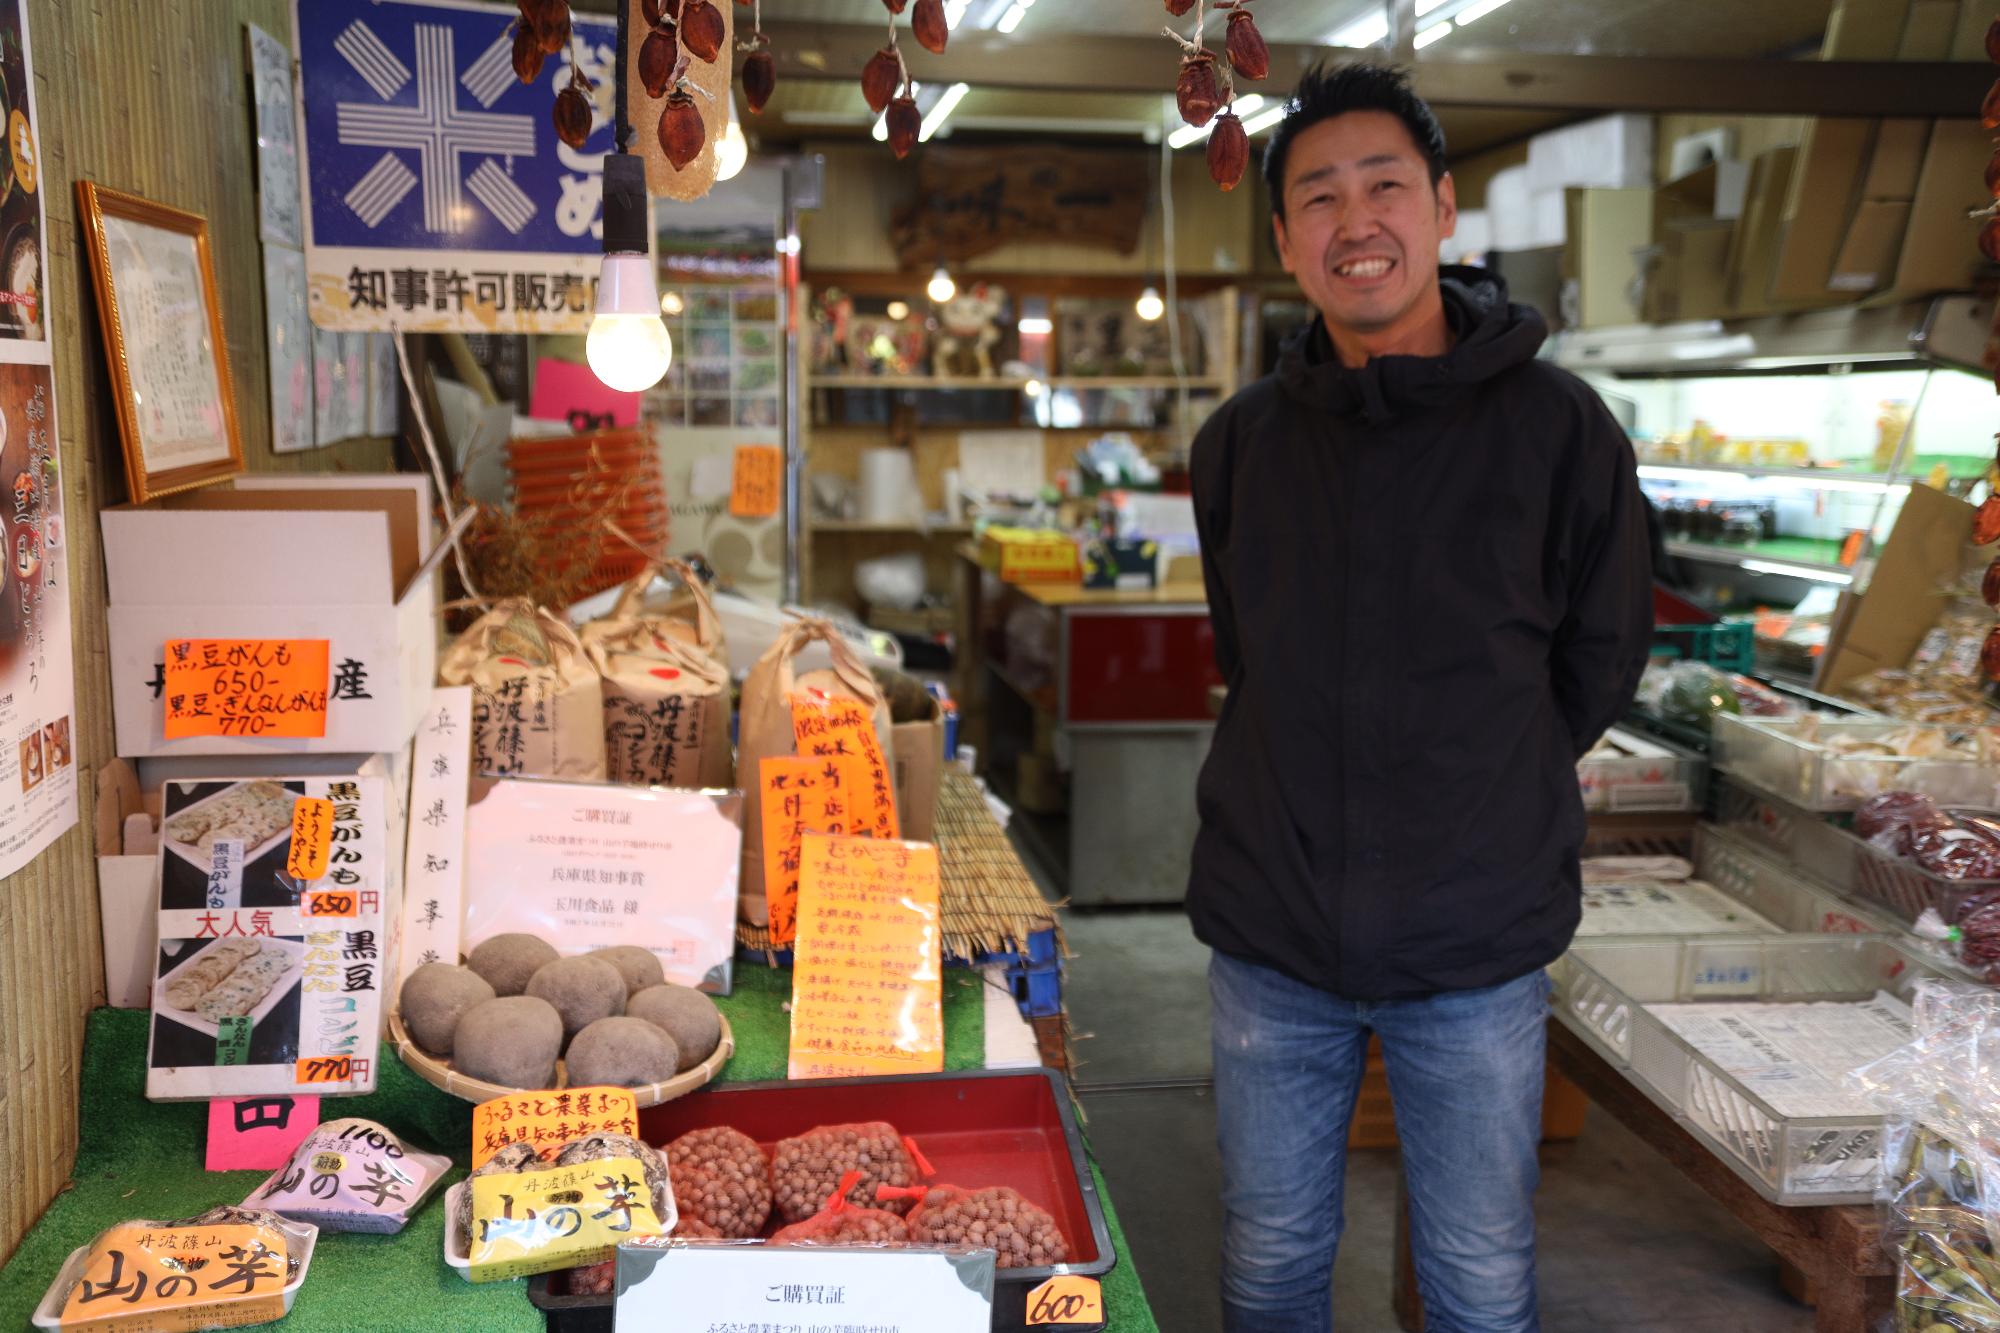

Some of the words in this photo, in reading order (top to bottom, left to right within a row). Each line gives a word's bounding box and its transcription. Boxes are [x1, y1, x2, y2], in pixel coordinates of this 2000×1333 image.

[348, 266, 601, 313] 知事許可販売
[171, 642, 292, 672] 黒豆がんも
[330, 657, 373, 700] 産
[326, 781, 364, 886] 黒豆がんも
[309, 893, 353, 916] 650
[360, 890, 379, 914] 円
[195, 909, 275, 938] 大人気
[340, 930, 378, 993] 黒豆
[305, 1057, 351, 1082] 770
[351, 1058, 370, 1084] 円
[338, 1124, 404, 1160] 1100
[522, 1167, 597, 1194] 丹波篠山
[478, 1172, 646, 1243] 山の芋
[135, 1232, 223, 1250] 丹波篠山
[78, 1244, 281, 1304] 山の芋
[765, 1283, 847, 1305] ご購買証
[1028, 1286, 1095, 1322] 600-
